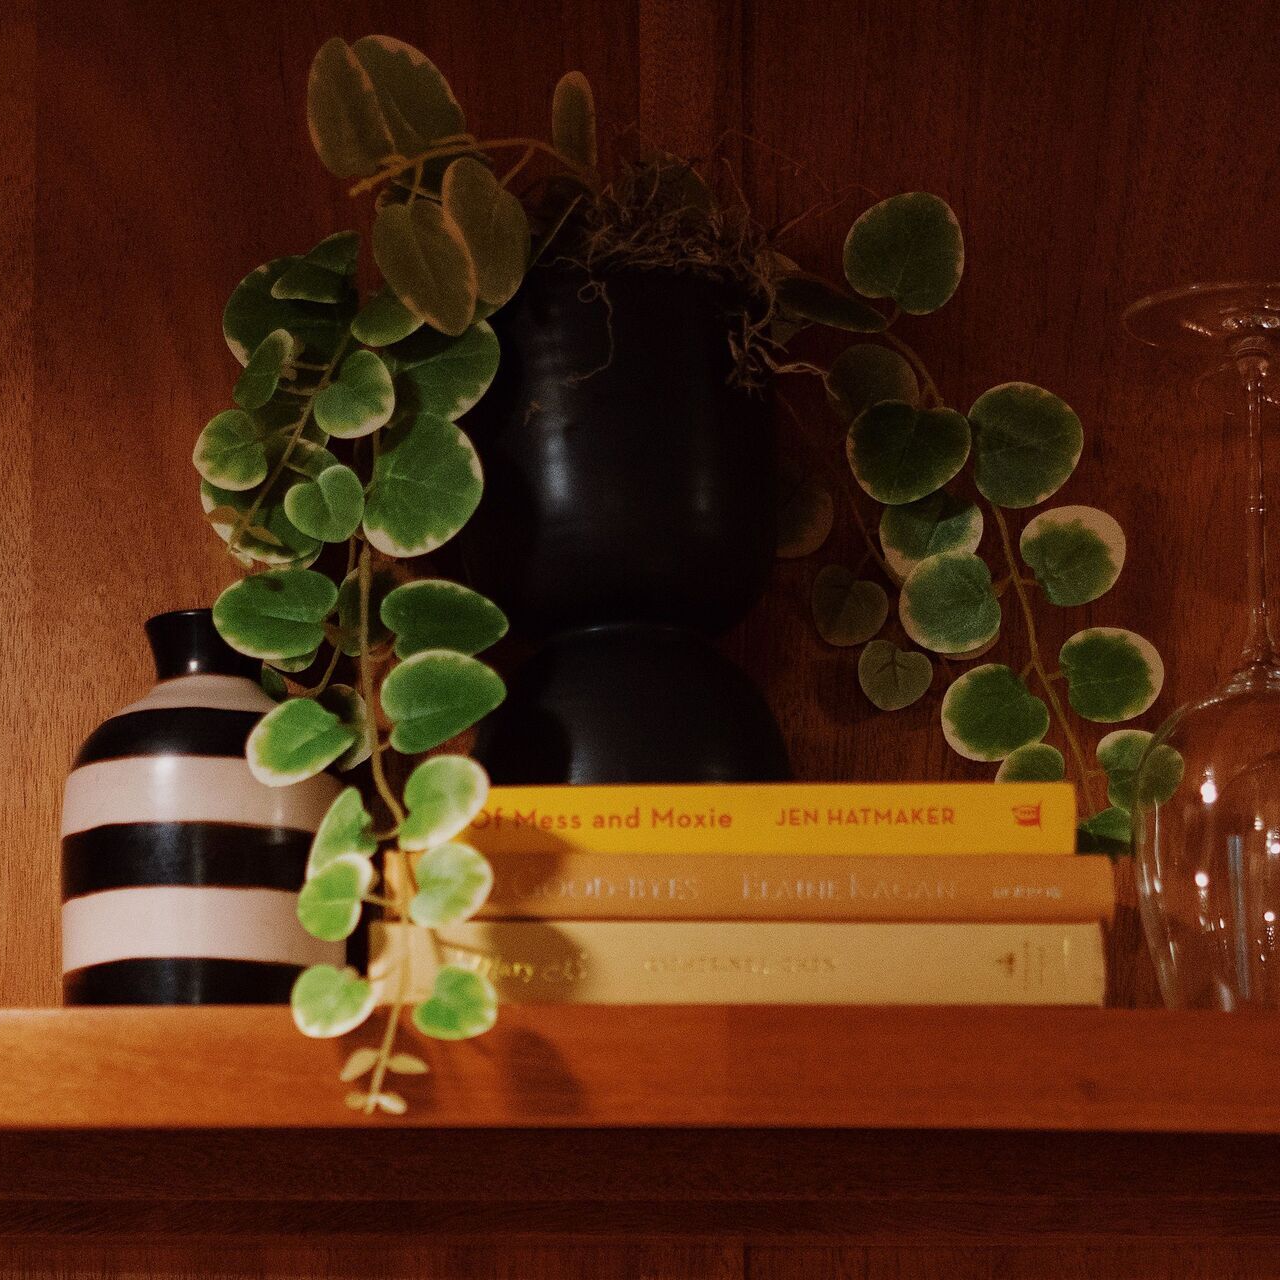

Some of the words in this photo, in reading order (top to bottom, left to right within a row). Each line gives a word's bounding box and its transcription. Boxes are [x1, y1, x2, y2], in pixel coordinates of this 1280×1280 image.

[469, 807, 503, 830] Of
[514, 808, 583, 831] Mess
[591, 806, 641, 830] and
[651, 807, 733, 829] Moxie
[775, 807, 819, 827] JEN
[827, 807, 956, 827] HATMAKER
